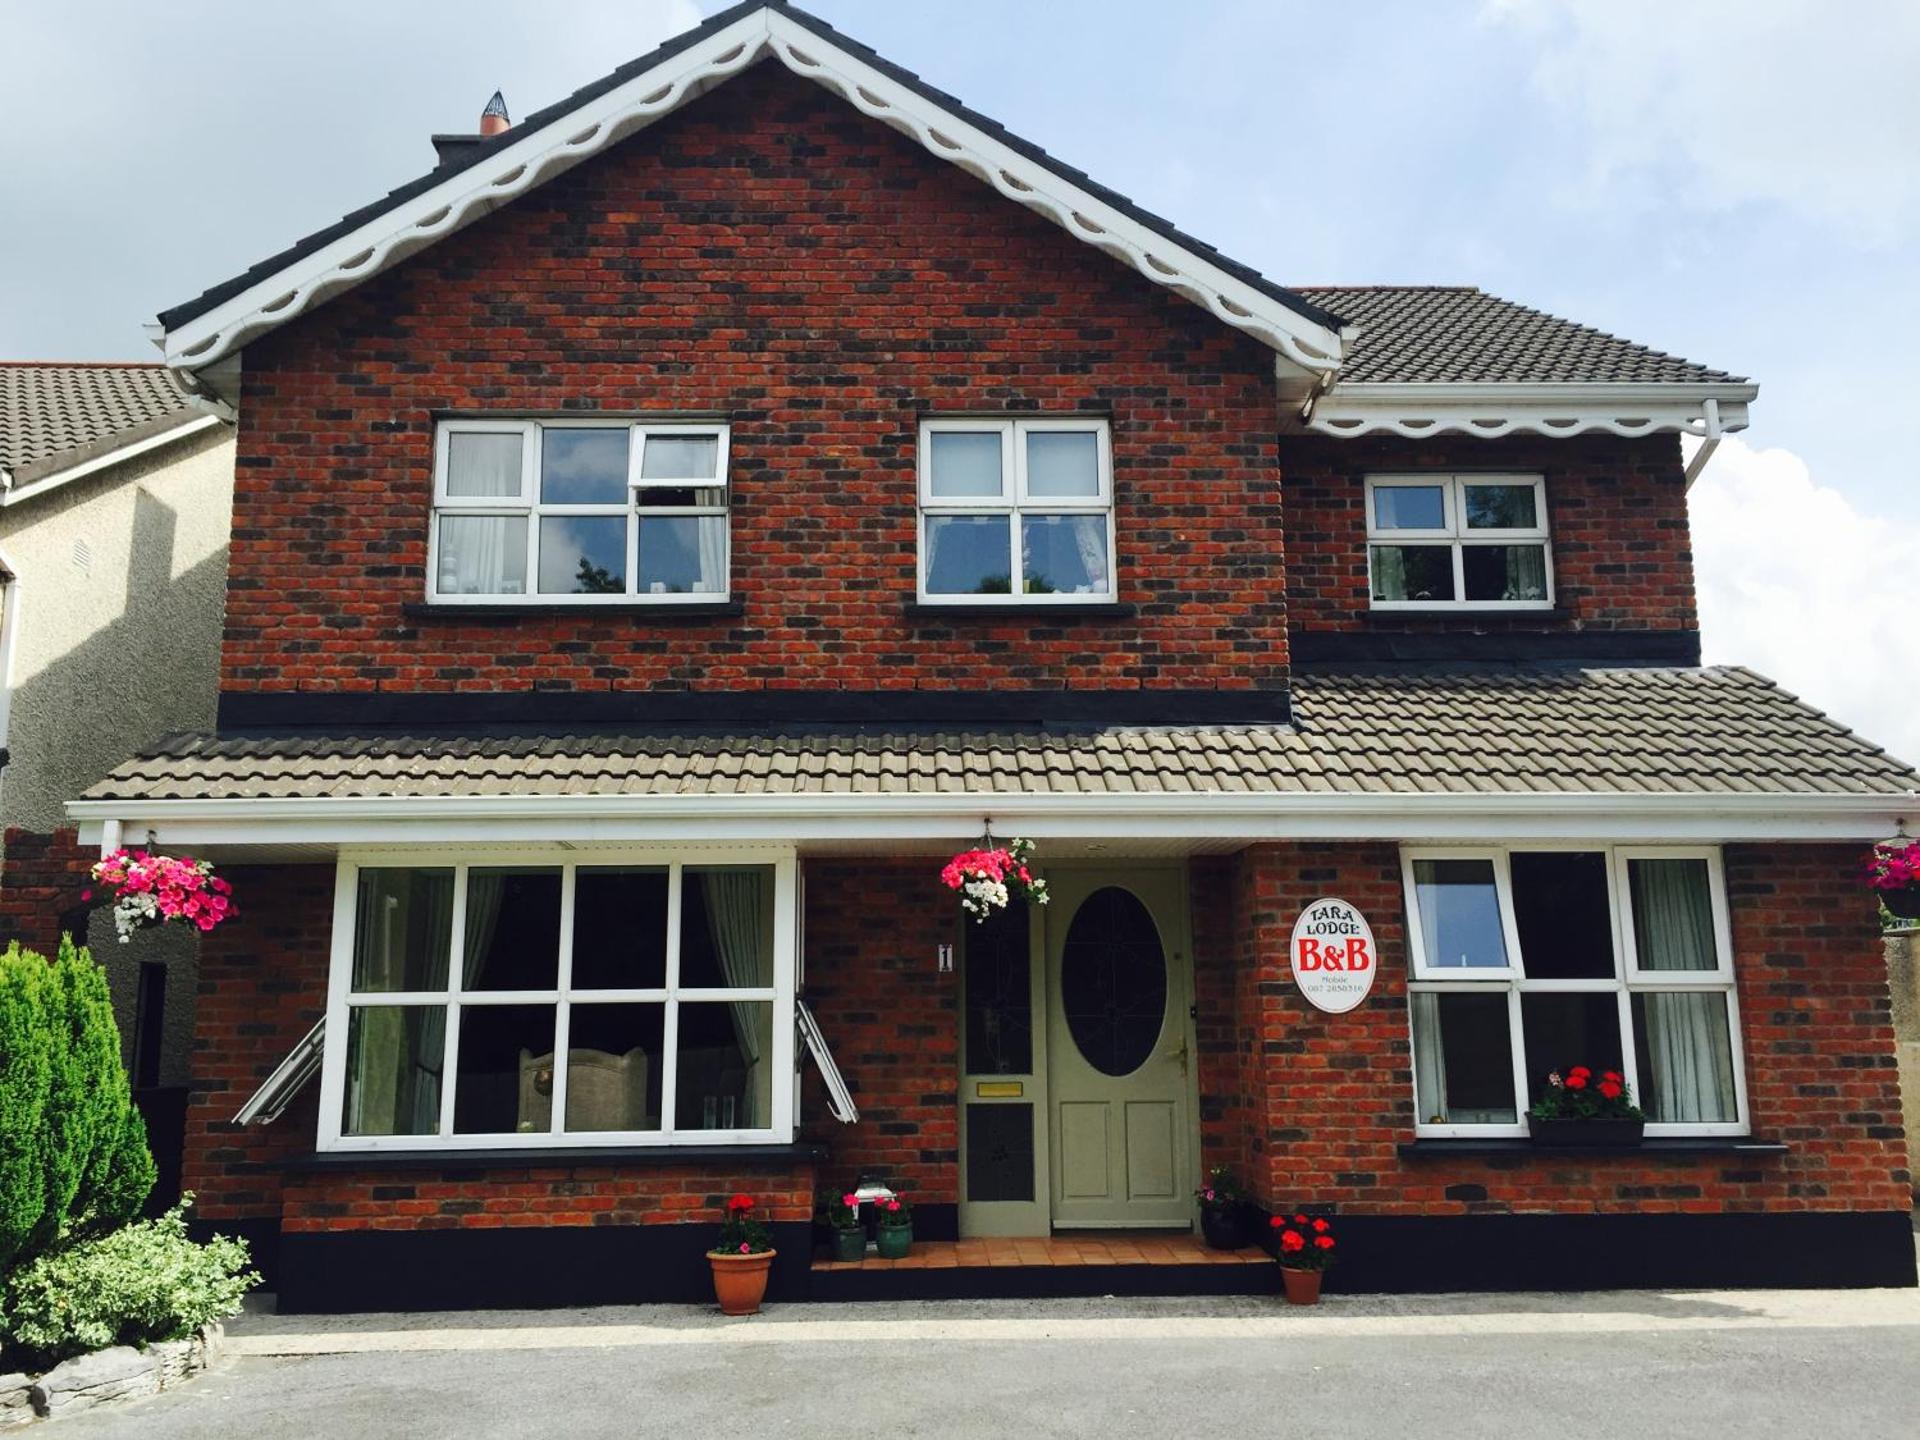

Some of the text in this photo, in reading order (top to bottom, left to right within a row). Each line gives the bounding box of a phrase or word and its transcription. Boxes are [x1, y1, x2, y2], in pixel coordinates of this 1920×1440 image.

[1311, 906, 1354, 922] TARA
[1307, 922, 1360, 934] LODGE
[1298, 939, 1369, 971] B&B
